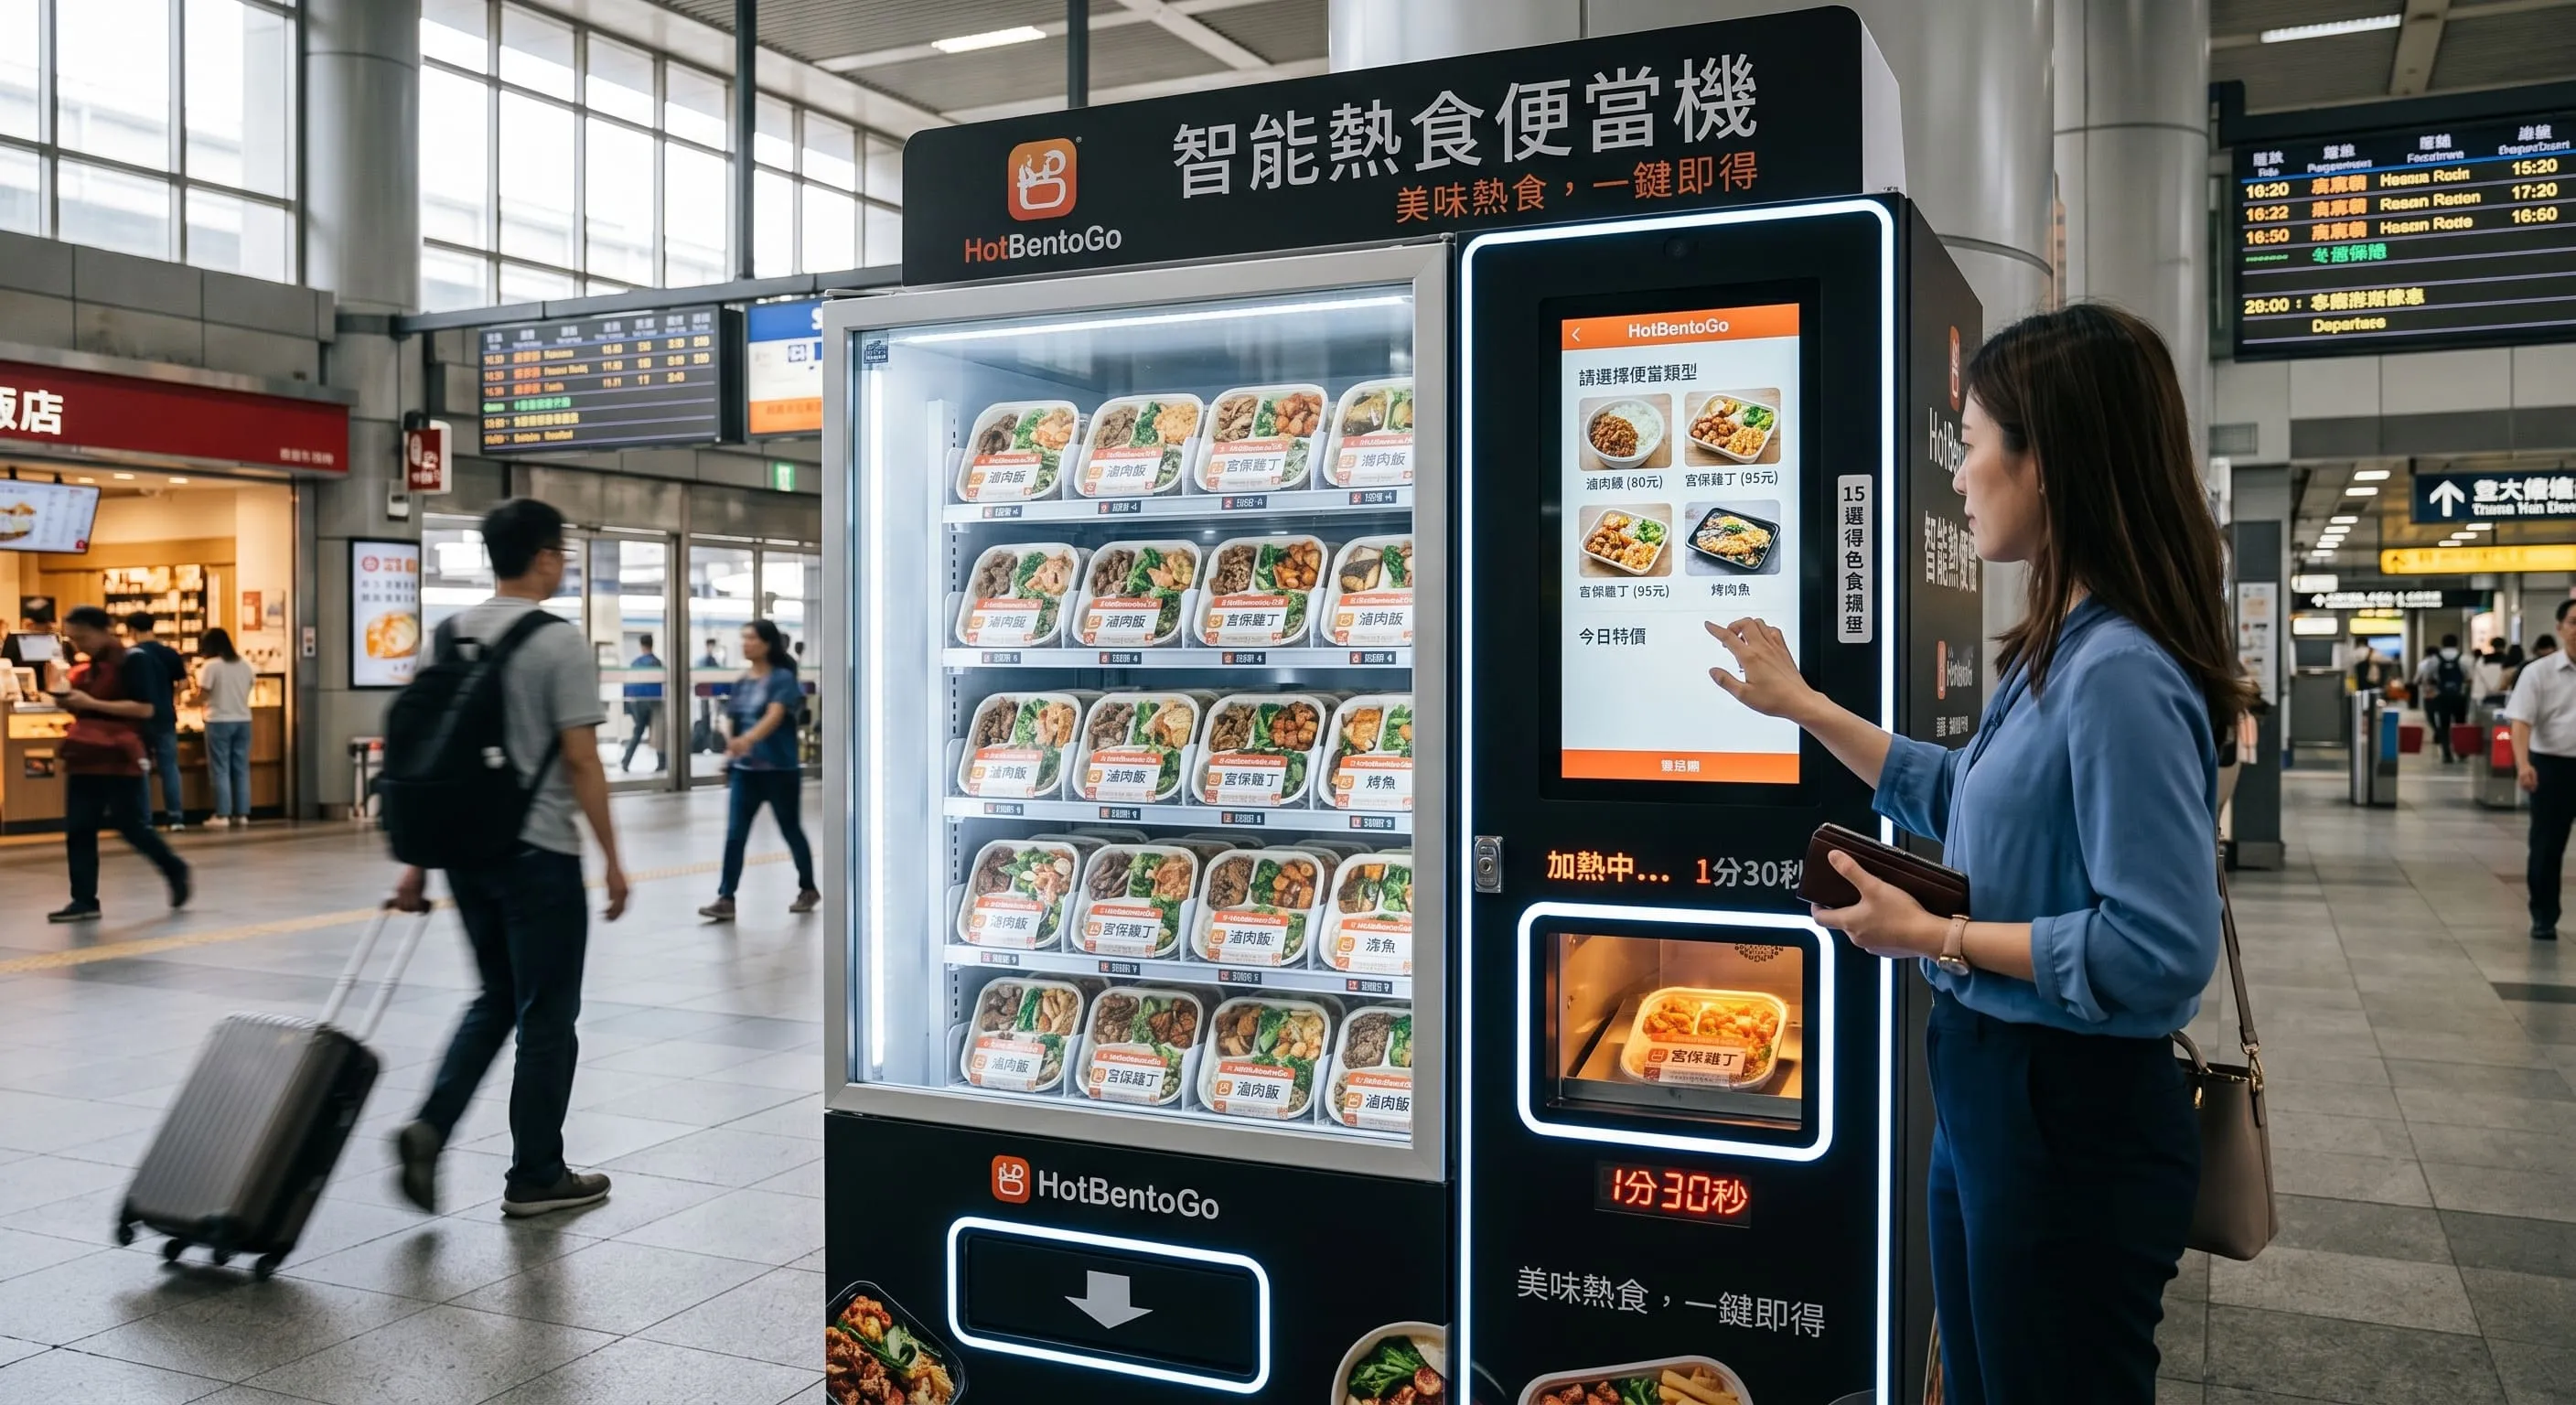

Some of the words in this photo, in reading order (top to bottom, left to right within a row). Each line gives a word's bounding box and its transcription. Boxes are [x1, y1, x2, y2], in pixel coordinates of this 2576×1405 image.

[1172, 53, 1757, 199] 智能熱食便當機
[2512, 158, 2558, 175] 15:20
[1395, 151, 1758, 224] 美味熱食，一鍵即得
[2512, 182, 2558, 199] 17:20
[965, 225, 1122, 263] HotBentoGo
[2246, 228, 2290, 244] 16:50
[1628, 317, 1729, 338] HotBentoGo
[1578, 362, 1698, 387] 請選擇便當類型
[1626, 475, 1663, 490] (80元)
[1740, 470, 1779, 487] (95元)
[1633, 584, 1669, 599] (95元)
[1578, 627, 1647, 646] 今日特價
[1671, 1048, 1738, 1067] 宮保雞丁
[1037, 1169, 1220, 1220] HotBentoGo
[1613, 1167, 1749, 1216] 1分30秒
[1517, 1265, 1826, 1338] 美味熱食，一鍵即得
